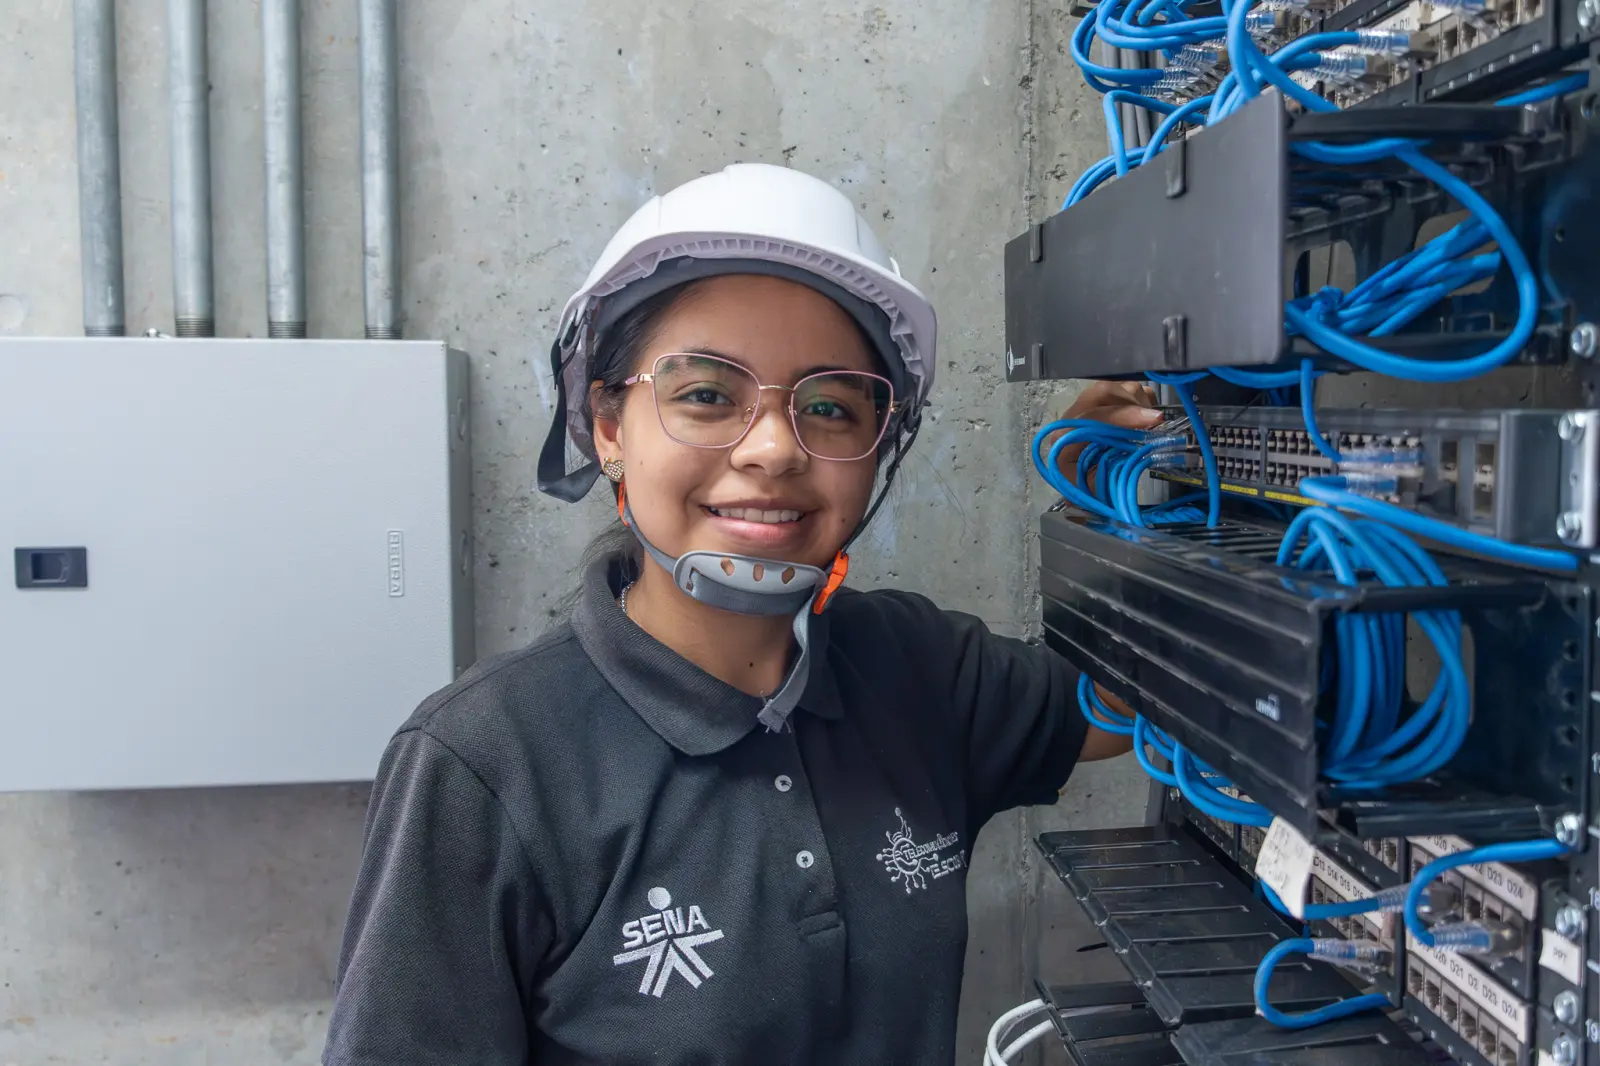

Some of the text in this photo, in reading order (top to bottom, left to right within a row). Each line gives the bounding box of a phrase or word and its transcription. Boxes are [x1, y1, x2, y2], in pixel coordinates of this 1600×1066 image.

[622, 905, 712, 950] SENA
[1449, 959, 1464, 979] D21
[1467, 973, 1479, 991] D2
[1482, 985, 1498, 1006] D23
